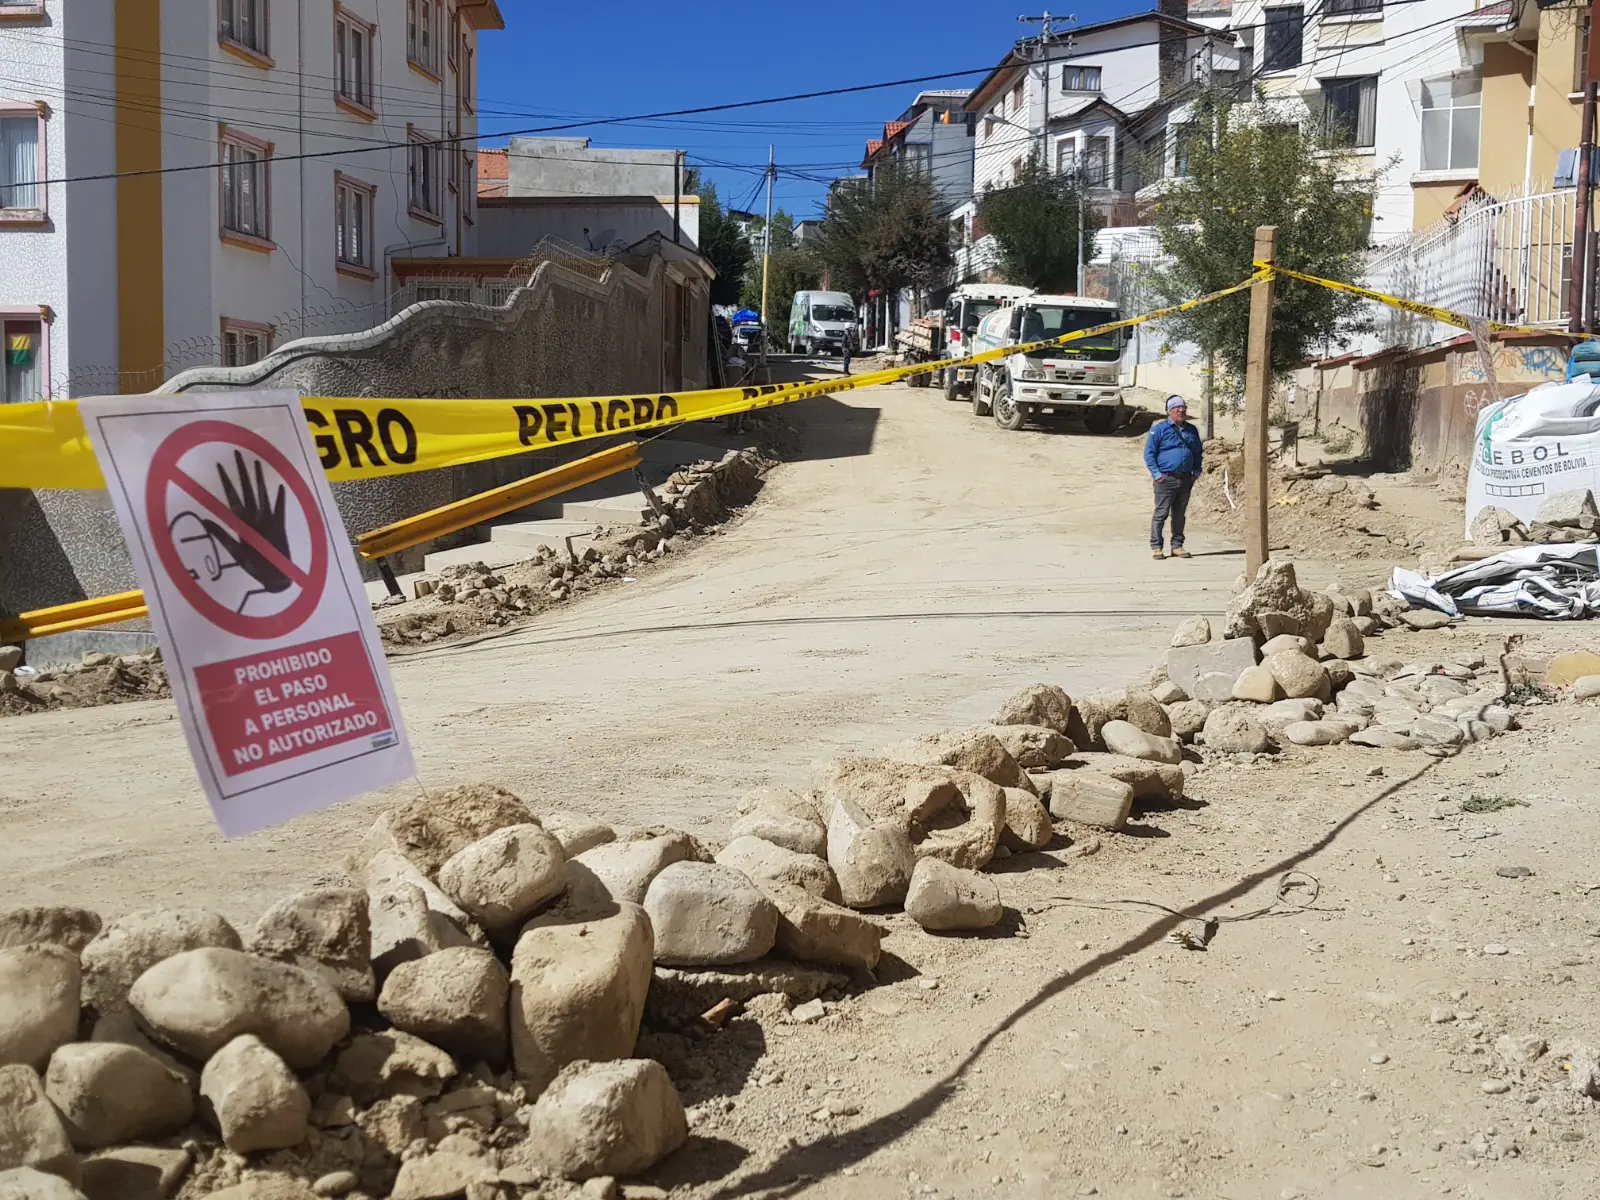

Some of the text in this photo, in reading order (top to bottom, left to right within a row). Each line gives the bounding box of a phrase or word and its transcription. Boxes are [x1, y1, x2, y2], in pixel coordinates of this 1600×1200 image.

[1521, 463, 1553, 479] CEMENTOS
[1554, 461, 1562, 473] DE
[1563, 457, 1587, 471] BOLIVIA
[234, 648, 332, 685] PROHIBIDO
[254, 674, 328, 706] EL PASO
[245, 693, 355, 736] A PERSONAL
[232, 743, 263, 765] NO
[268, 710, 378, 755] AUTORIZADO
